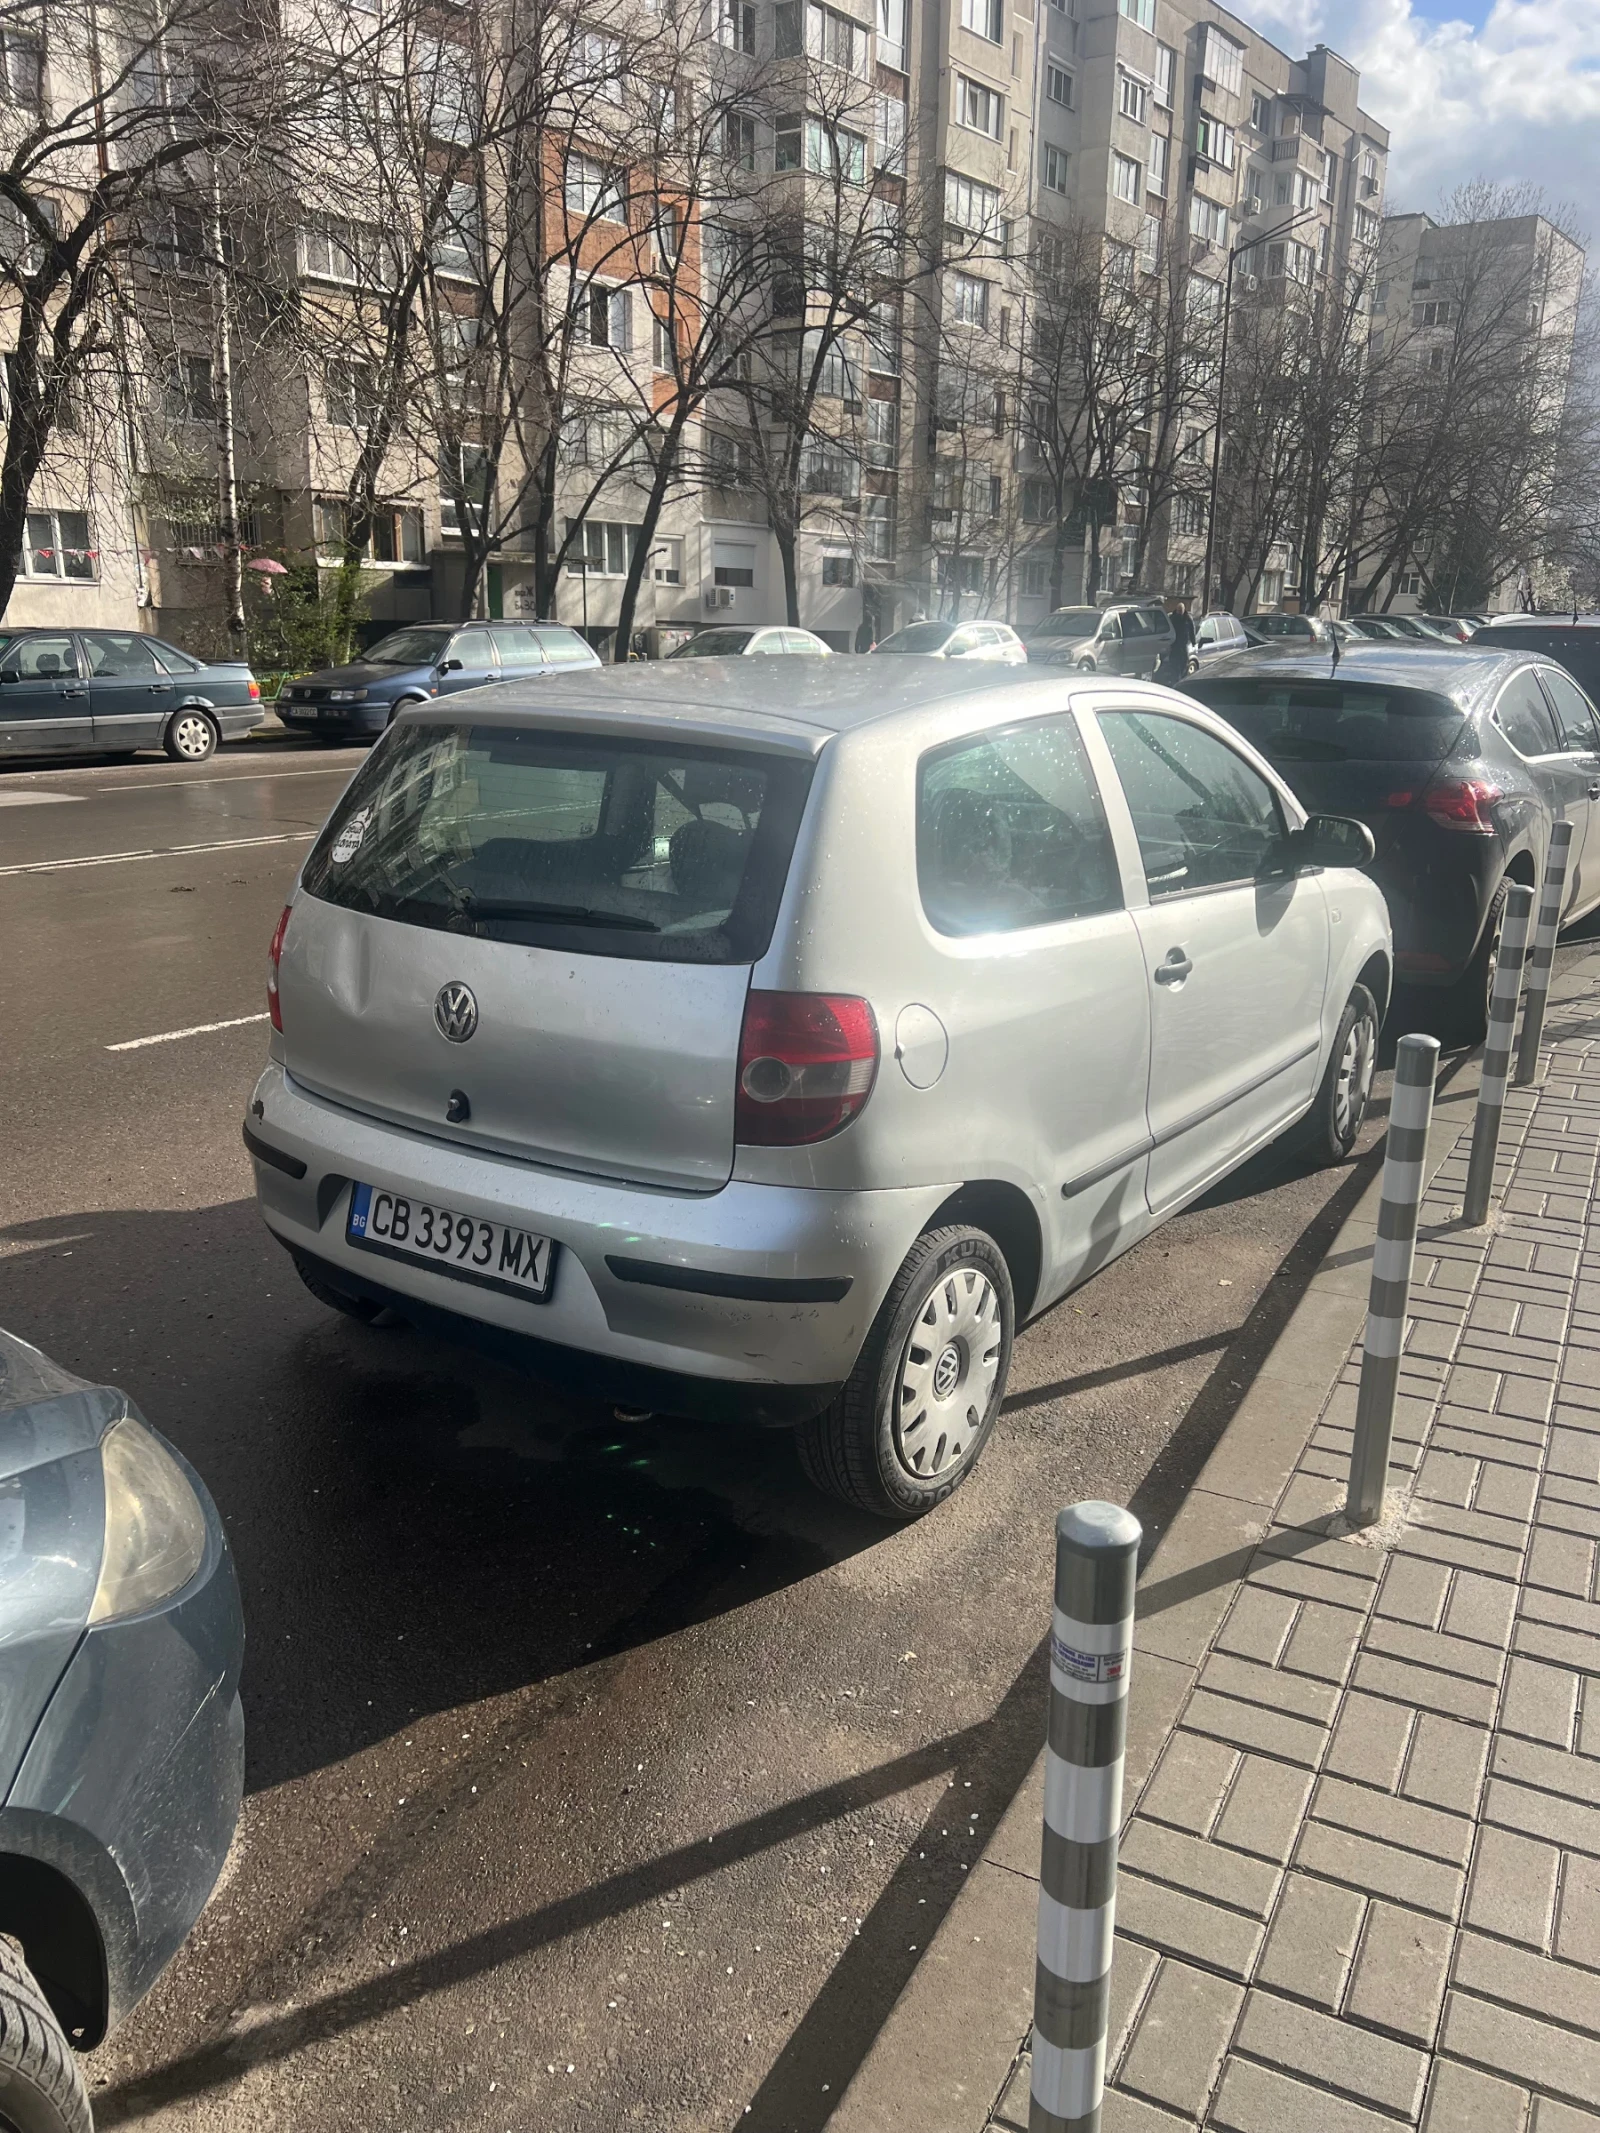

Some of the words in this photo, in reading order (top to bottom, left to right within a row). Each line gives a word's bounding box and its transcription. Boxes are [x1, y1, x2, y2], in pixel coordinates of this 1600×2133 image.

[353, 1214, 366, 1227] BG
[372, 1194, 411, 1241] CB
[414, 1206, 494, 1265] 3393
[498, 1229, 544, 1283] MX
